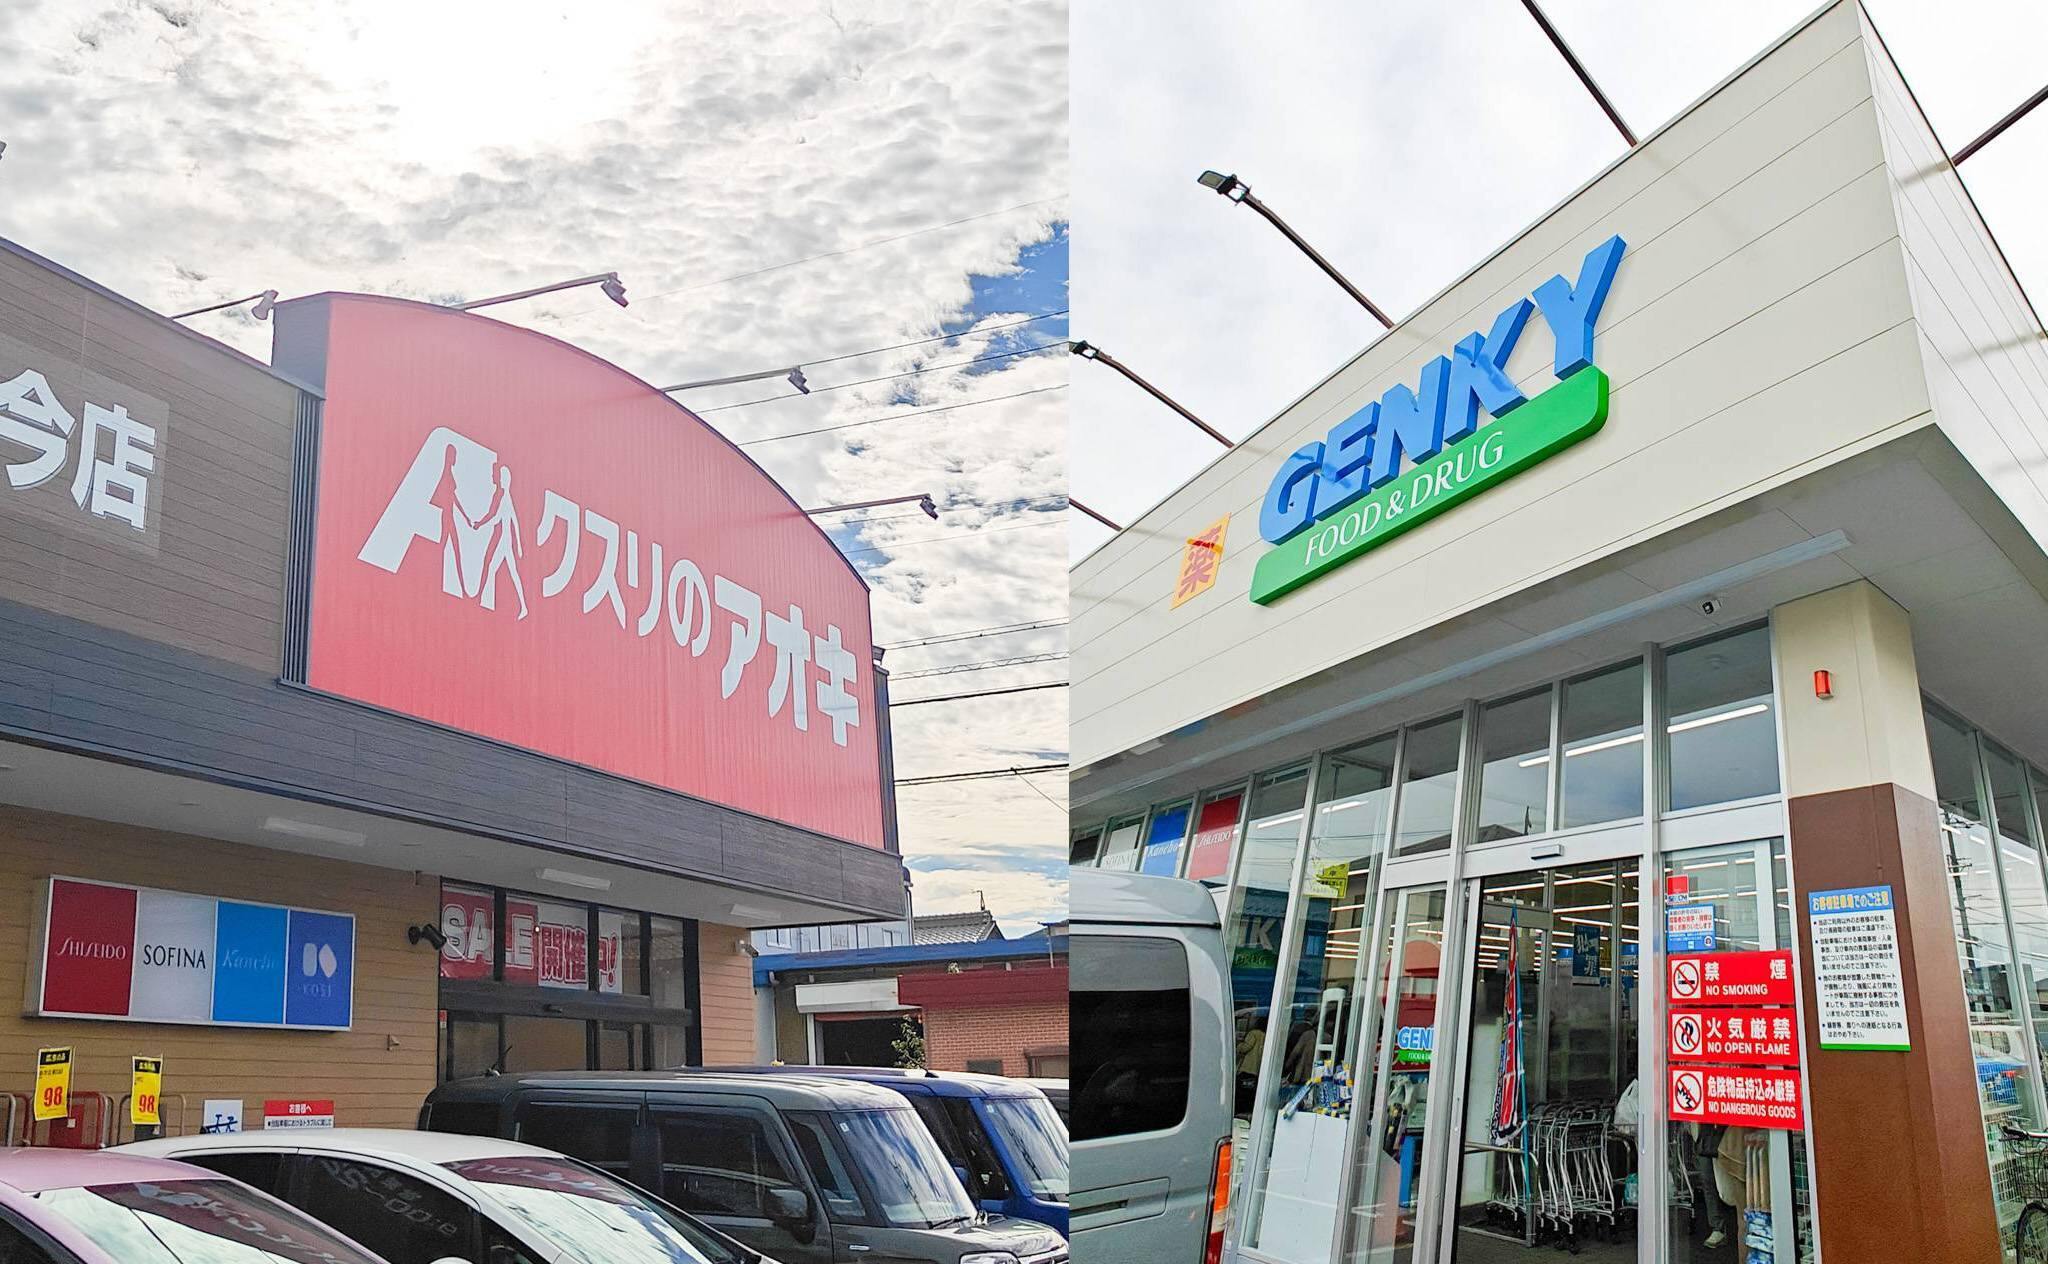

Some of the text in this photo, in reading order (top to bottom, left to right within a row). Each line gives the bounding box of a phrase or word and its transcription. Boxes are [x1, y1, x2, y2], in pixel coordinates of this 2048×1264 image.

[1258, 233, 1627, 545] GENKY
[1303, 430, 1504, 565] FOOD & DRUG
[537, 489, 860, 748] クスリのアオキ
[57, 936, 126, 960] SHISEIDO
[143, 944, 207, 969] SOFINA
[1706, 984, 1769, 996] NO SMOKING
[1706, 1017, 1791, 1040] 火気厳禁
[1707, 1042, 1791, 1055] NO OPEN FLAME
[43, 1086, 63, 1107] 98
[1707, 1074, 1796, 1104] 危険物品持込み厳禁
[138, 1094, 156, 1113] 98
[1708, 1101, 1797, 1119] NO DANGEROUS GOODS
